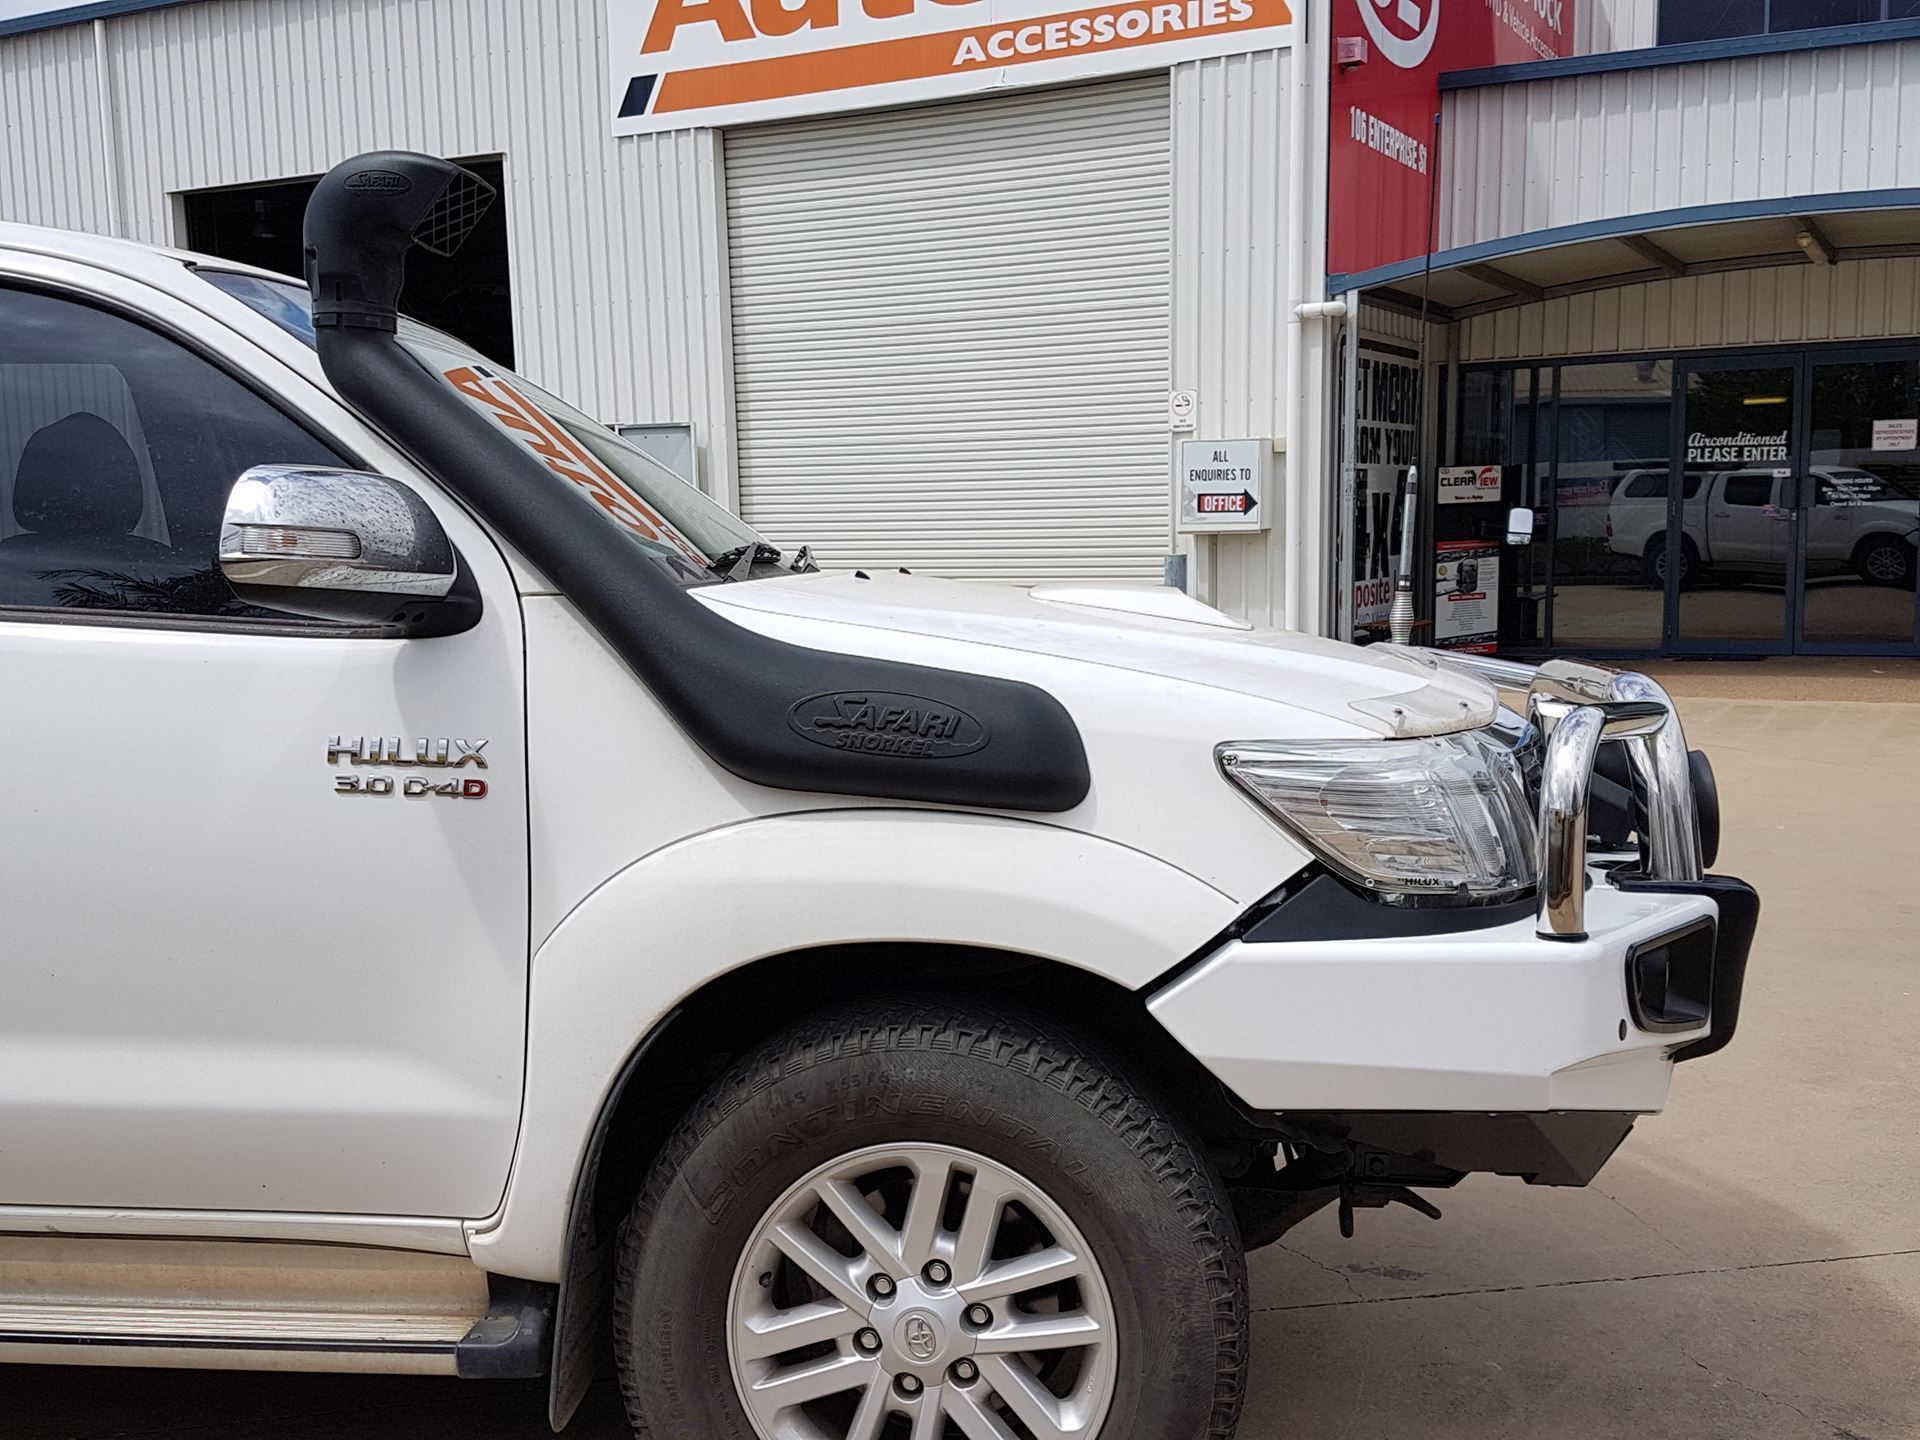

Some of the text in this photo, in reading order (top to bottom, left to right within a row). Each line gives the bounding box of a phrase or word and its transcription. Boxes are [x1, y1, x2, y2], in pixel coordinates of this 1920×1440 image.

[952, 0, 1254, 65] ACCESSORIES
[1350, 106, 1367, 144] 106
[1368, 115, 1418, 171] ENTERPRISE
[1687, 430, 1788, 447] Airconditioned
[1212, 450, 1229, 463] ALL
[1687, 446, 1788, 463] PLEASE ENTER
[1189, 467, 1251, 482] ENQUIRIES TO
[1205, 495, 1243, 511] OFFICE
[814, 697, 962, 738] SAFARI
[327, 735, 488, 769] HILUX
[836, 732, 933, 757] SNORKEL
[1404, 878, 1440, 886] HILUX
